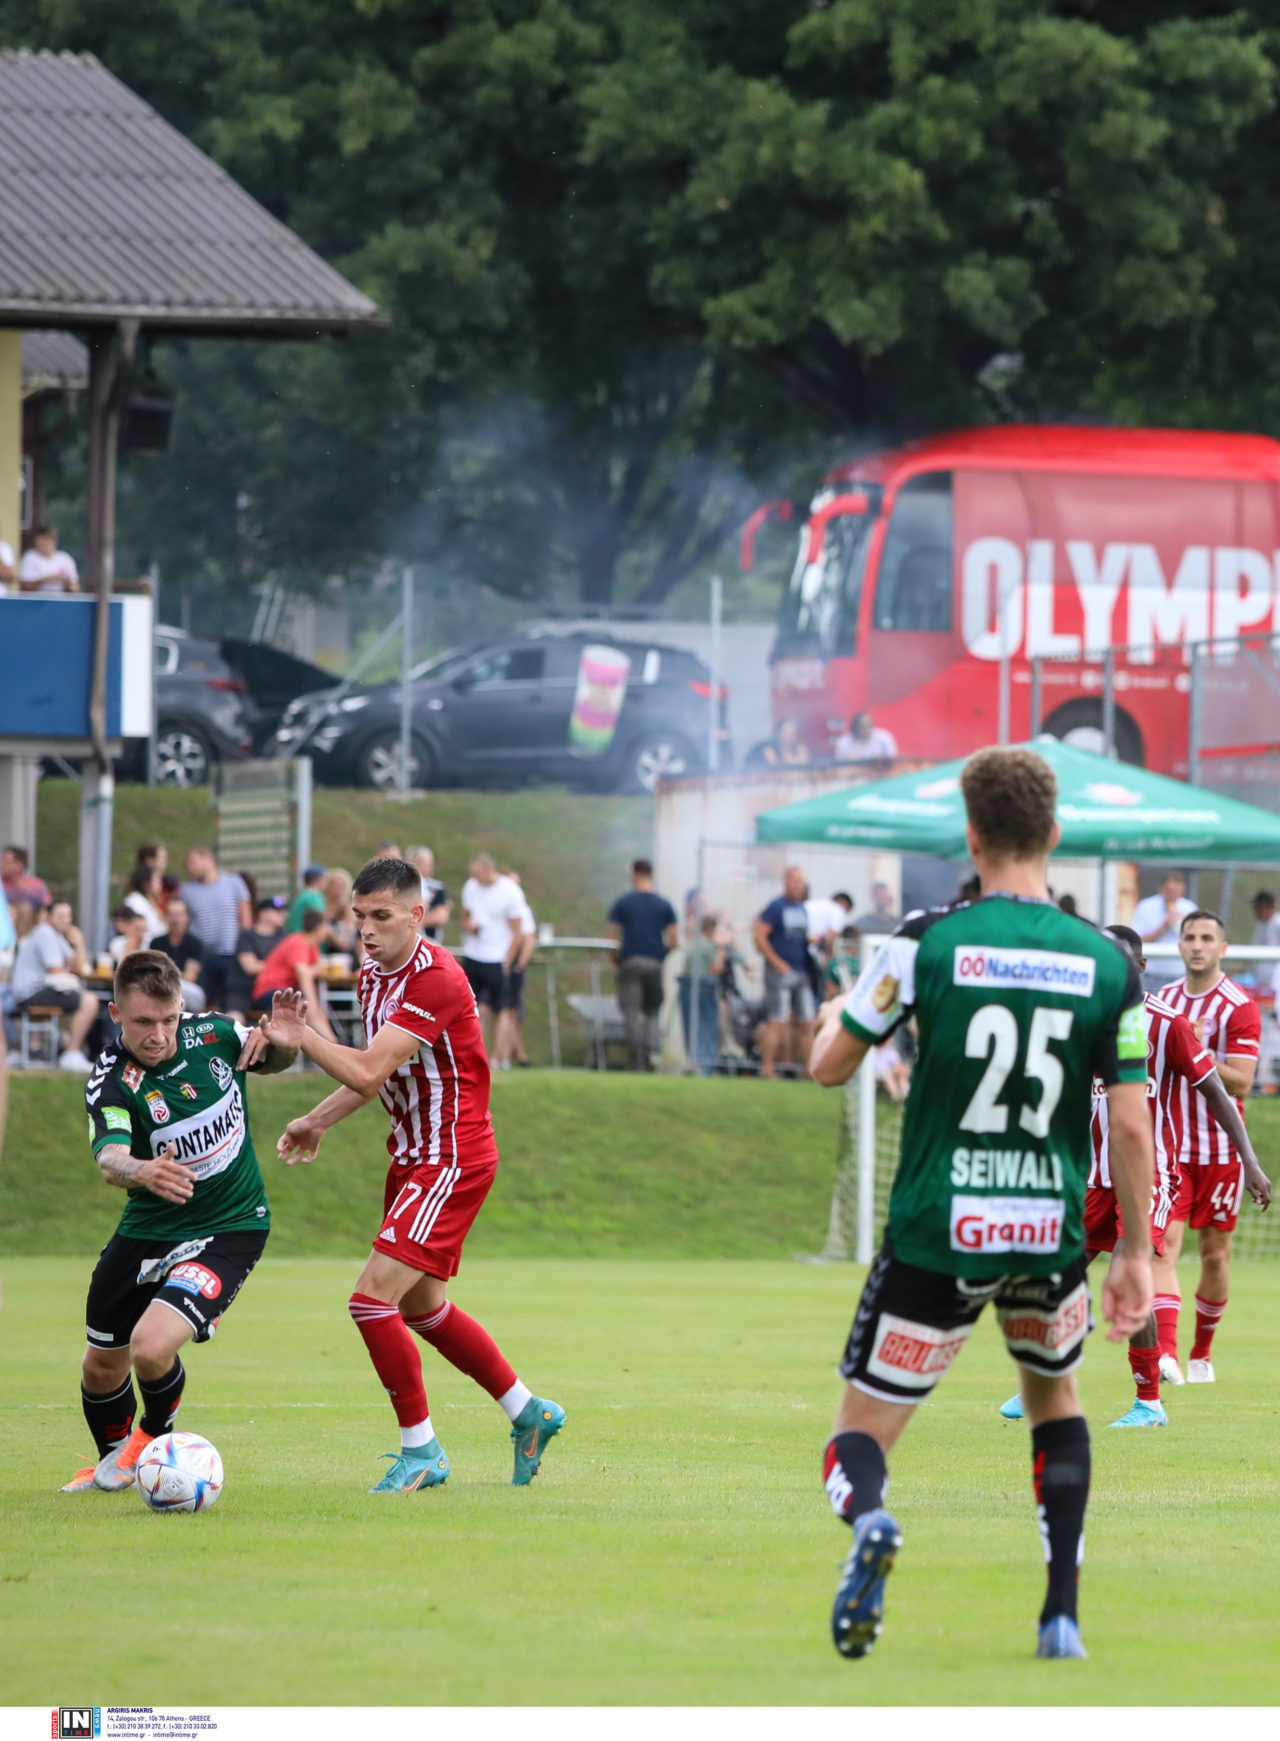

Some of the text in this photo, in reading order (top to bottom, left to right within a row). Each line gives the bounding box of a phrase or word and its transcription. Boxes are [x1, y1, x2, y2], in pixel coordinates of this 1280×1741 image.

[183, 1032, 220, 1049] DAXL
[958, 1003, 1074, 1139] 25
[387, 1181, 423, 1220] 17
[1210, 1181, 1236, 1211] 44
[954, 1215, 1060, 1250] Granit
